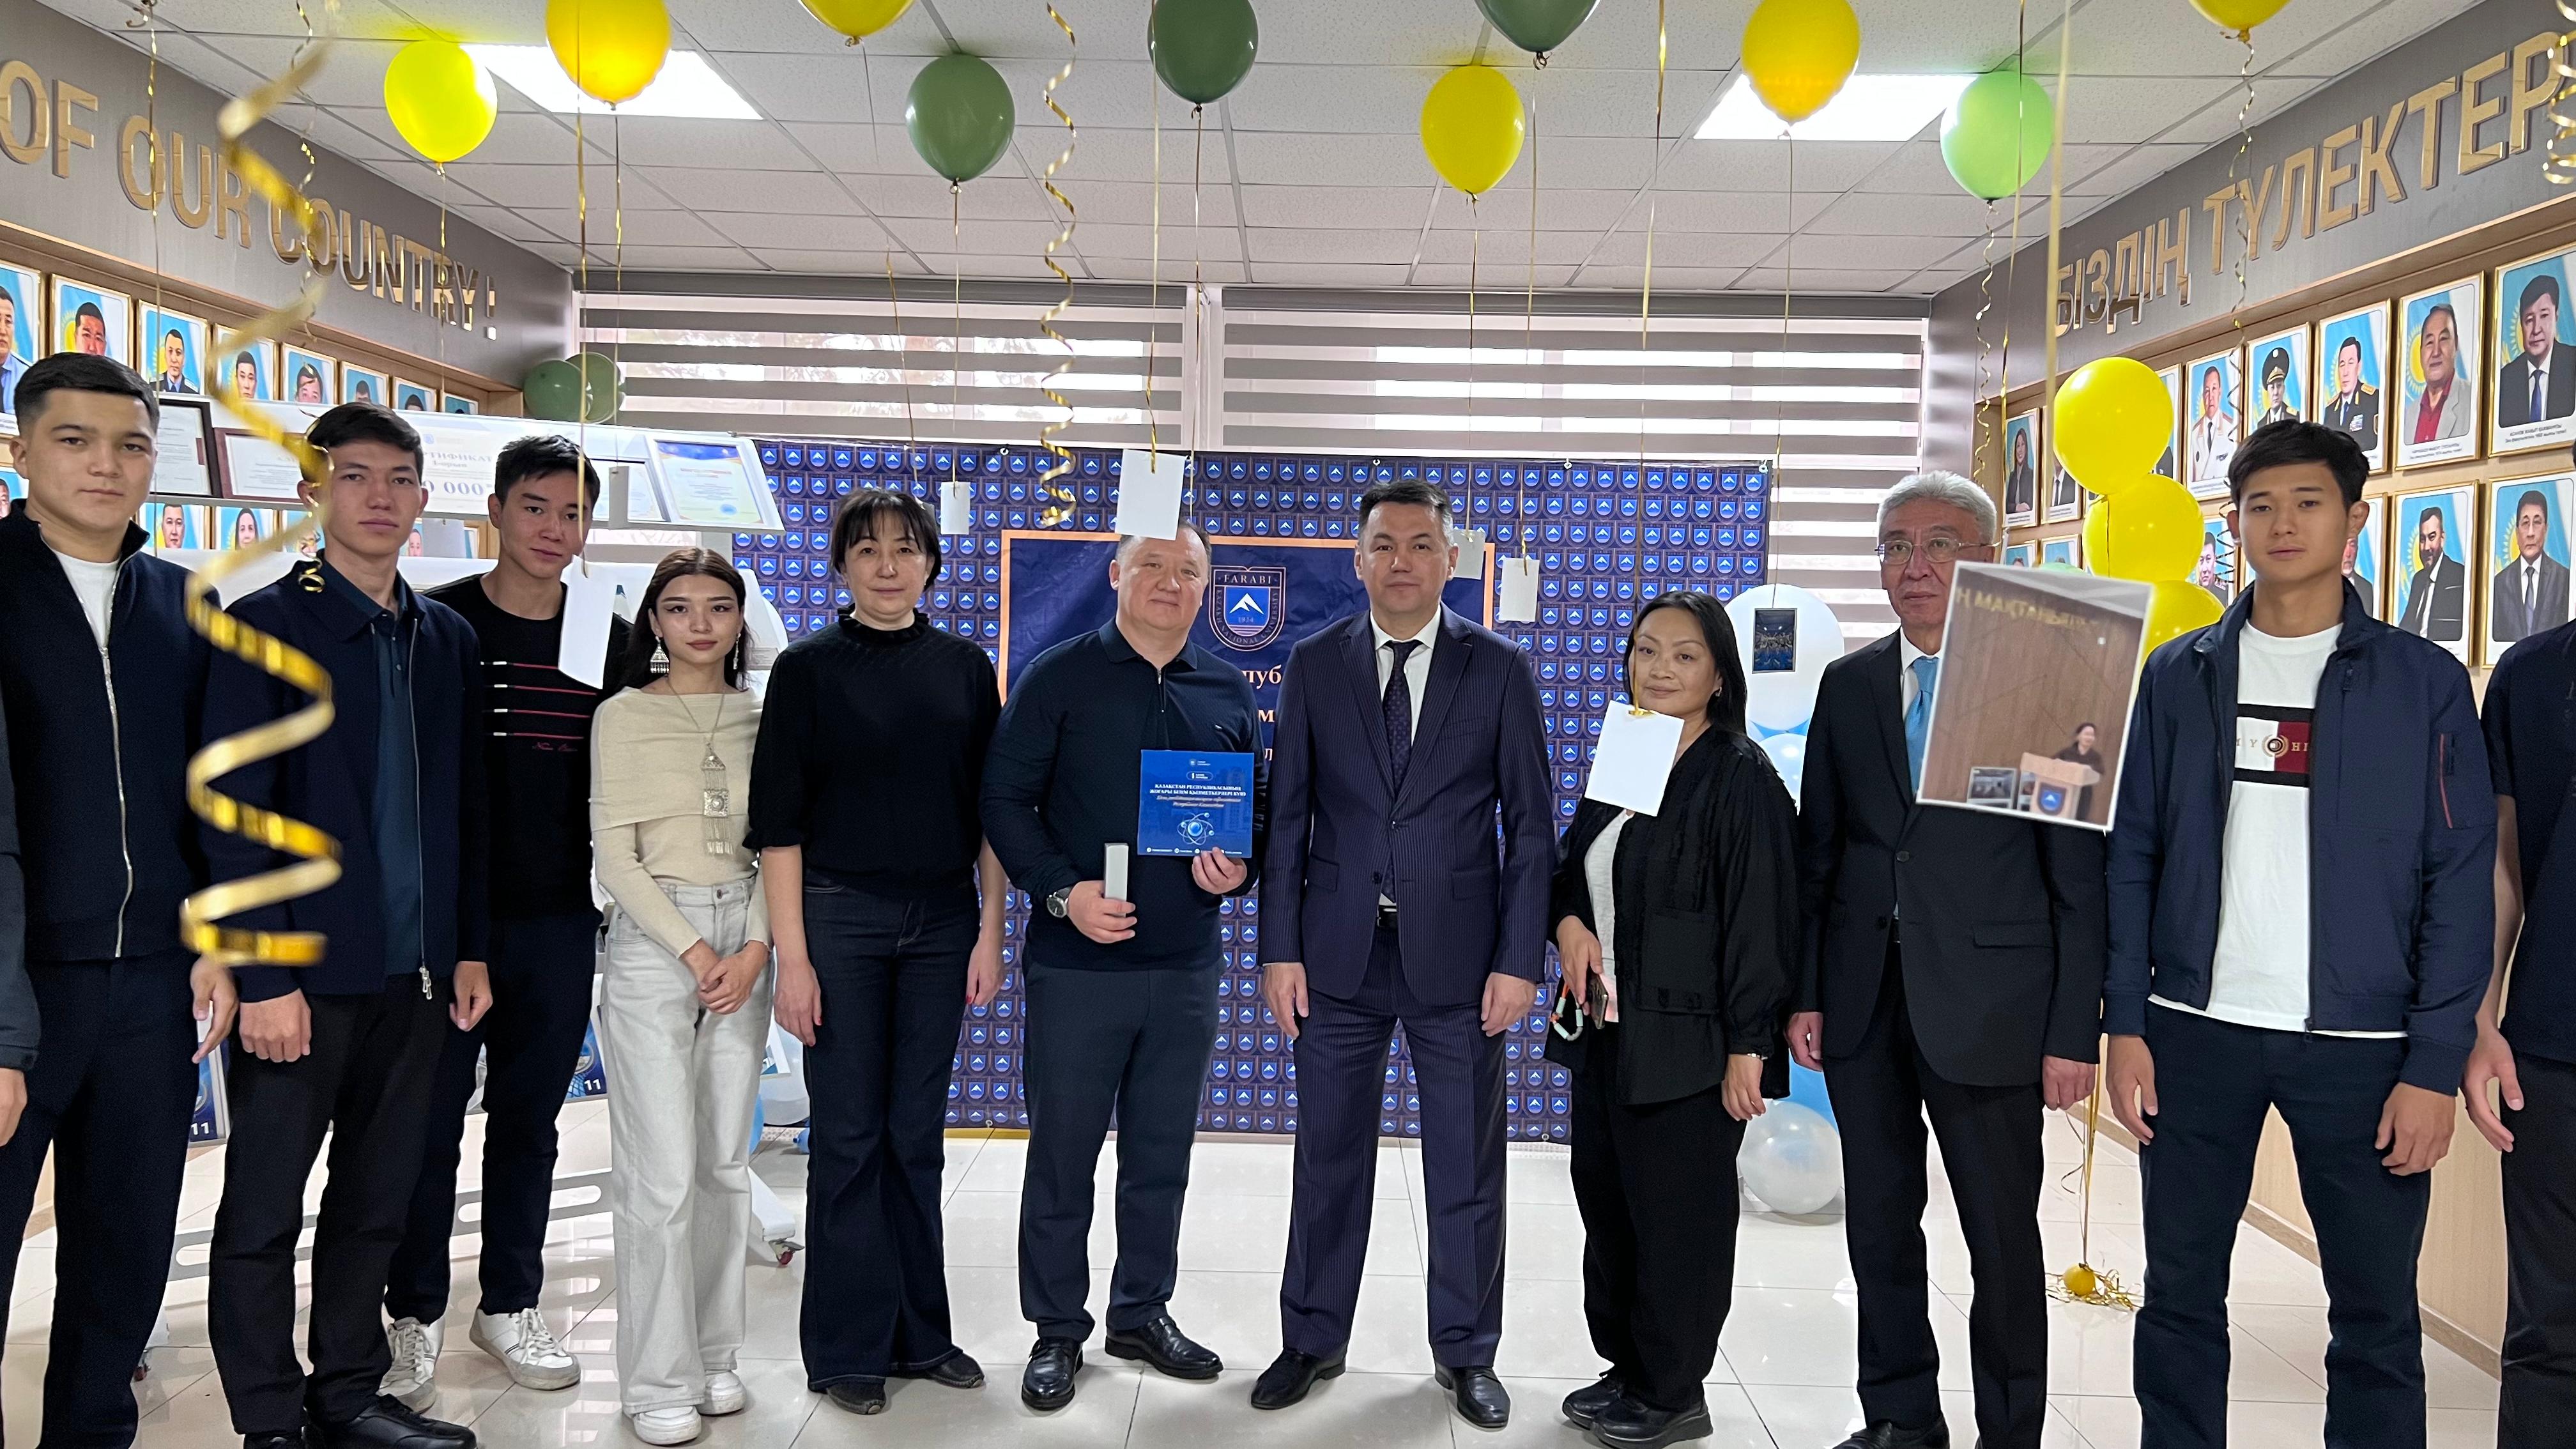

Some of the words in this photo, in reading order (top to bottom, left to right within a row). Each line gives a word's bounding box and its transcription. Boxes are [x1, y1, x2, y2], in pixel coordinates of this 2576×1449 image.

[0, 60, 98, 179] OF
[118, 115, 252, 249] OUR
[424, 451, 492, 462] ТИФИКАТ
[1223, 574, 1271, 585] FARABI
[2291, 742, 2310, 752] HI
